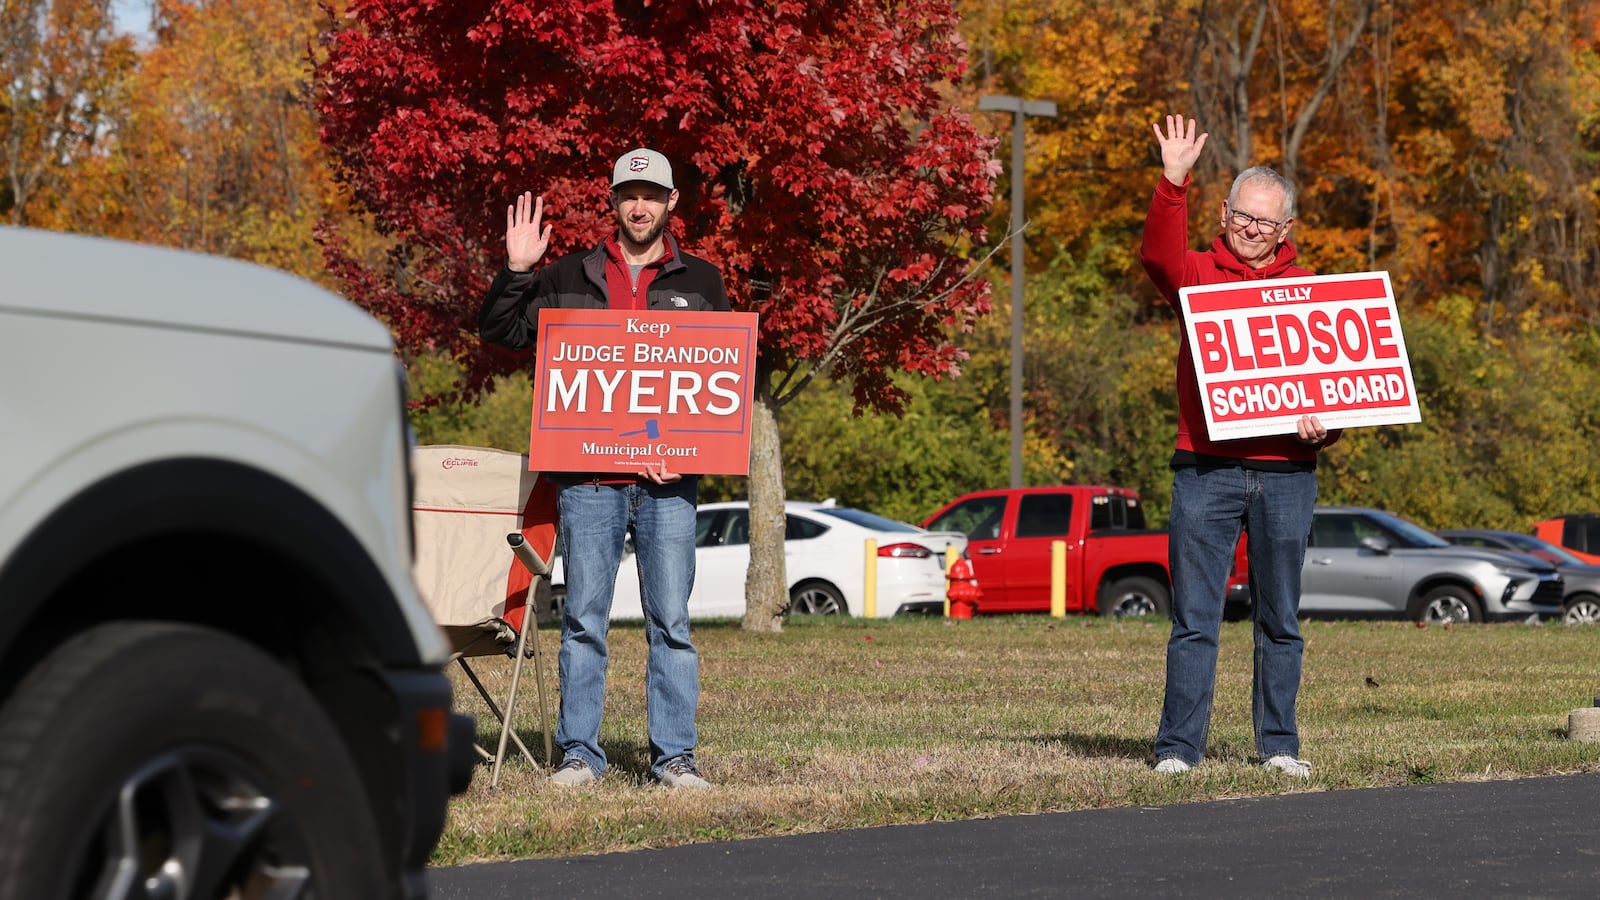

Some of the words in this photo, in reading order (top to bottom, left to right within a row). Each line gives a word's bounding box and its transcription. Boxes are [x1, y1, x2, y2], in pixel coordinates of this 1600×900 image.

[1260, 287, 1312, 303] KELLY
[625, 318, 671, 338] Keep
[1194, 307, 1400, 374] BLEDSOE
[552, 342, 626, 363] JUDGE
[633, 343, 739, 364] BRANDON
[546, 368, 742, 416] MYERS
[1211, 380, 1315, 417] SCHOOL
[1319, 373, 1405, 406] BOARD
[581, 442, 652, 459] Municipal
[656, 443, 698, 457] Court
